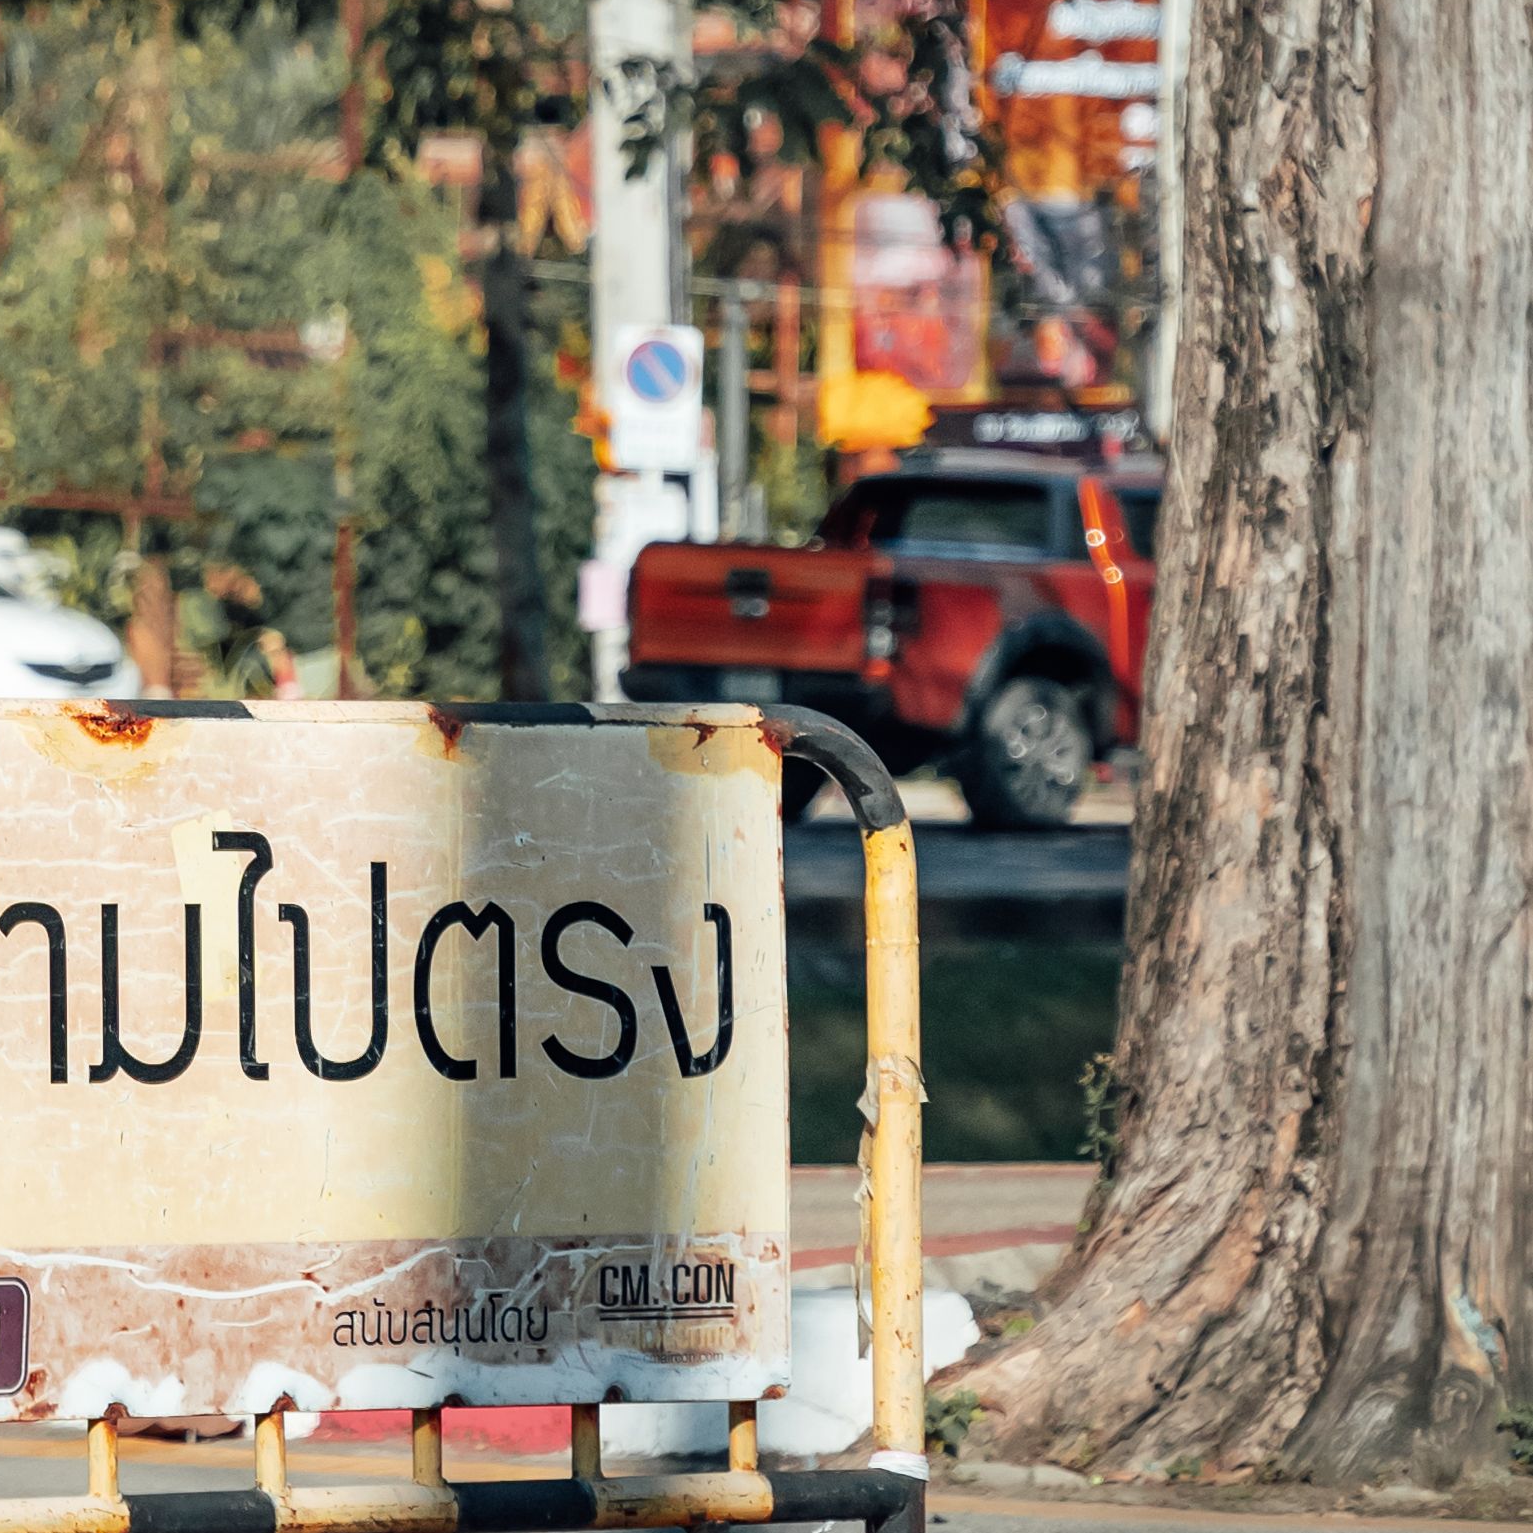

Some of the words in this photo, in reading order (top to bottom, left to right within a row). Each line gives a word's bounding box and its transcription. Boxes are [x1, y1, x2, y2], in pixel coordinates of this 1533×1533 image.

[332, 1293, 549, 1357] สนับสนุนโดย
